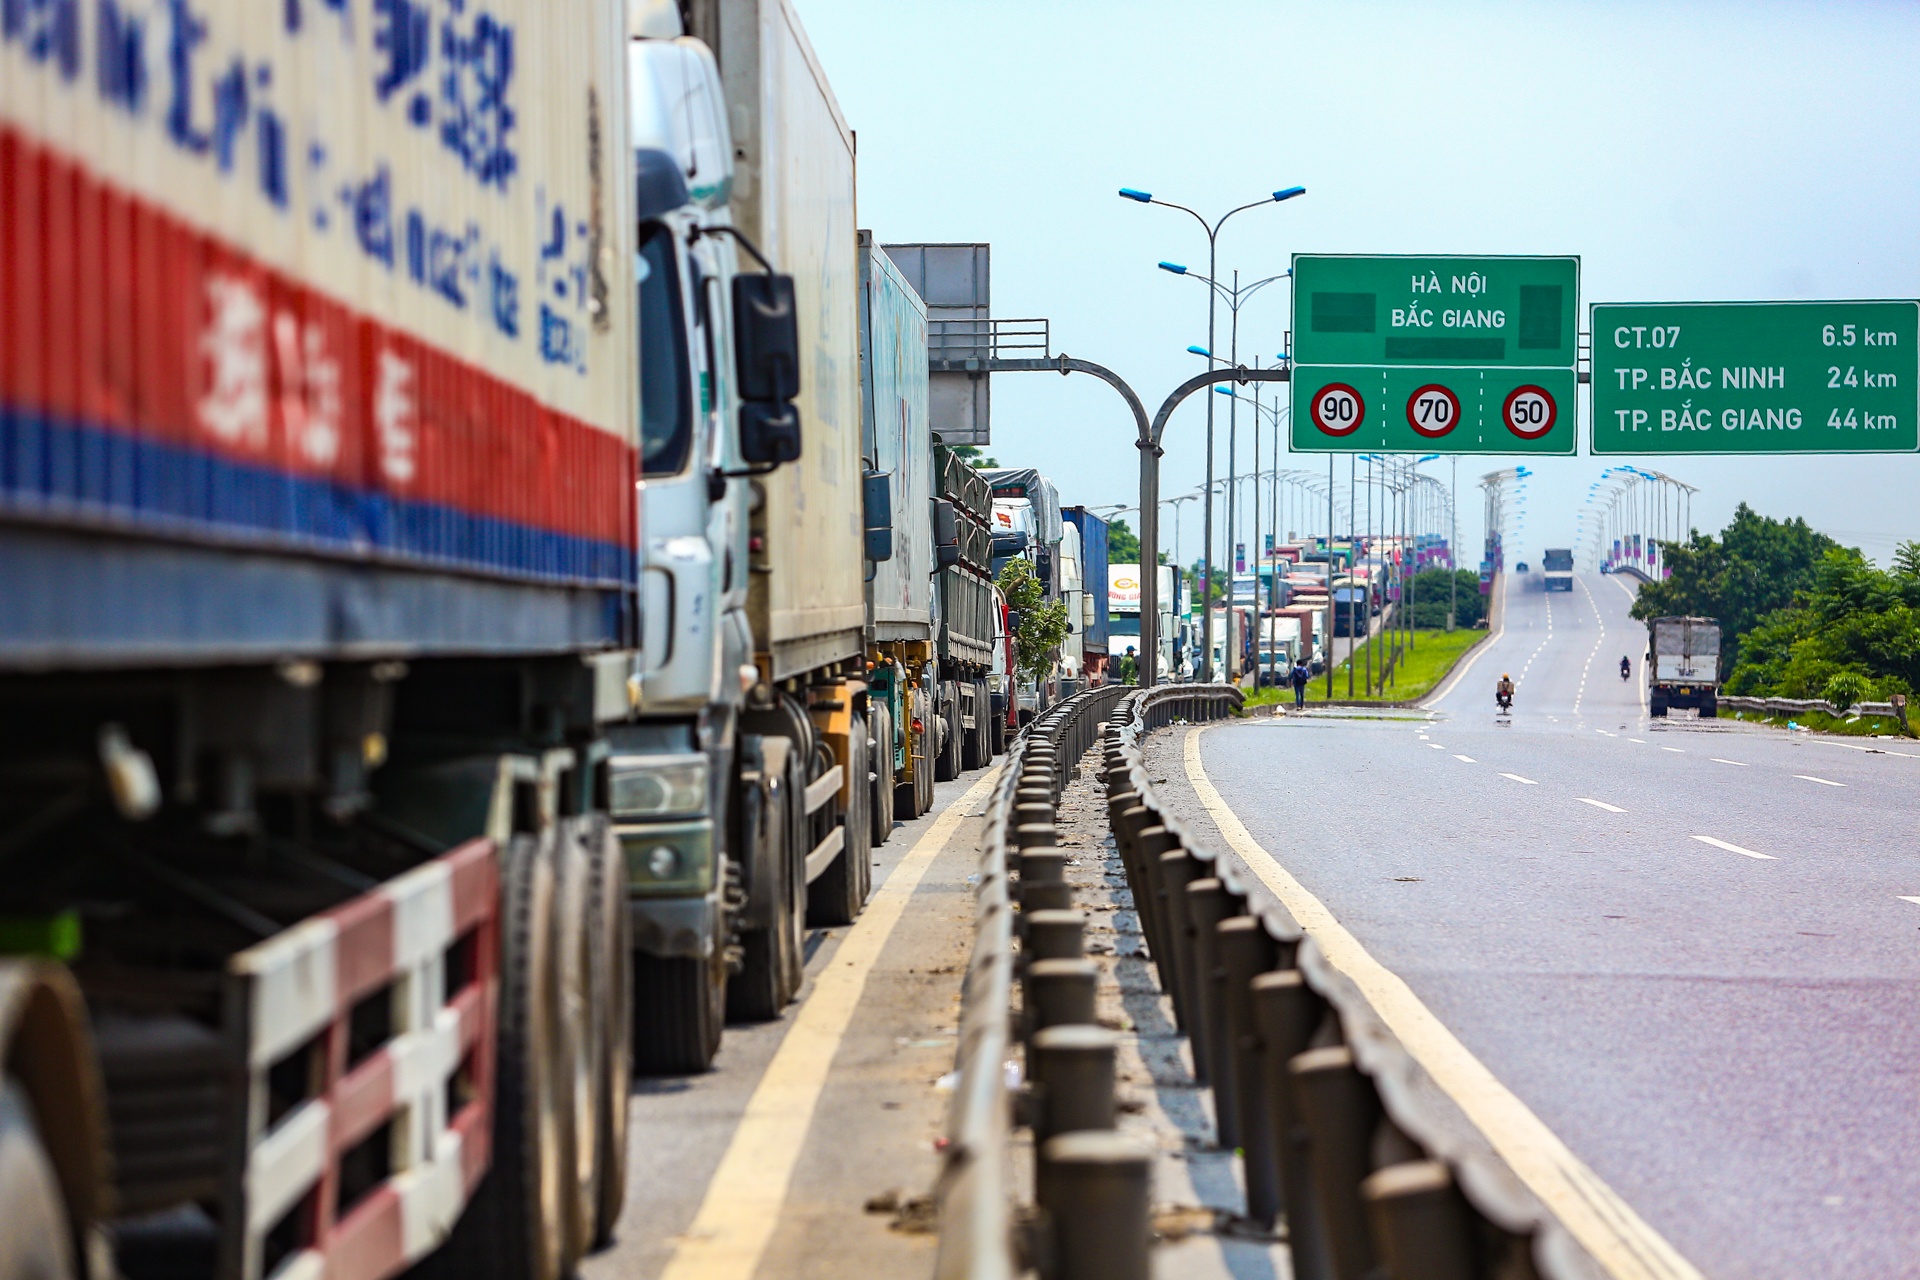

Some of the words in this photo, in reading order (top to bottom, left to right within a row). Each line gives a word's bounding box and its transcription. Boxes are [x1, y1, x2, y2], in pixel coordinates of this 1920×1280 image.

[1411, 270, 1442, 293] HÀ
[1451, 271, 1487, 298] NỘI
[1391, 300, 1434, 327] BẮC
[1442, 309, 1506, 328] GIANG
[1614, 326, 1682, 349] CT.07
[1822, 324, 1856, 346] 6.5
[1864, 328, 1897, 346] km
[1614, 368, 1655, 390] TP.
[1660, 357, 1712, 390] BẮC
[1722, 367, 1785, 389] NINH
[1827, 366, 1859, 388] 24
[1864, 370, 1897, 387] km
[1323, 396, 1353, 421] 90
[1419, 398, 1449, 423] 70
[1514, 400, 1543, 424] 50
[1614, 409, 1653, 431] TP.
[1660, 399, 1712, 431] BẮC
[1721, 408, 1802, 430] GIANG
[1826, 408, 1858, 429] 44
[1864, 411, 1897, 429] km
